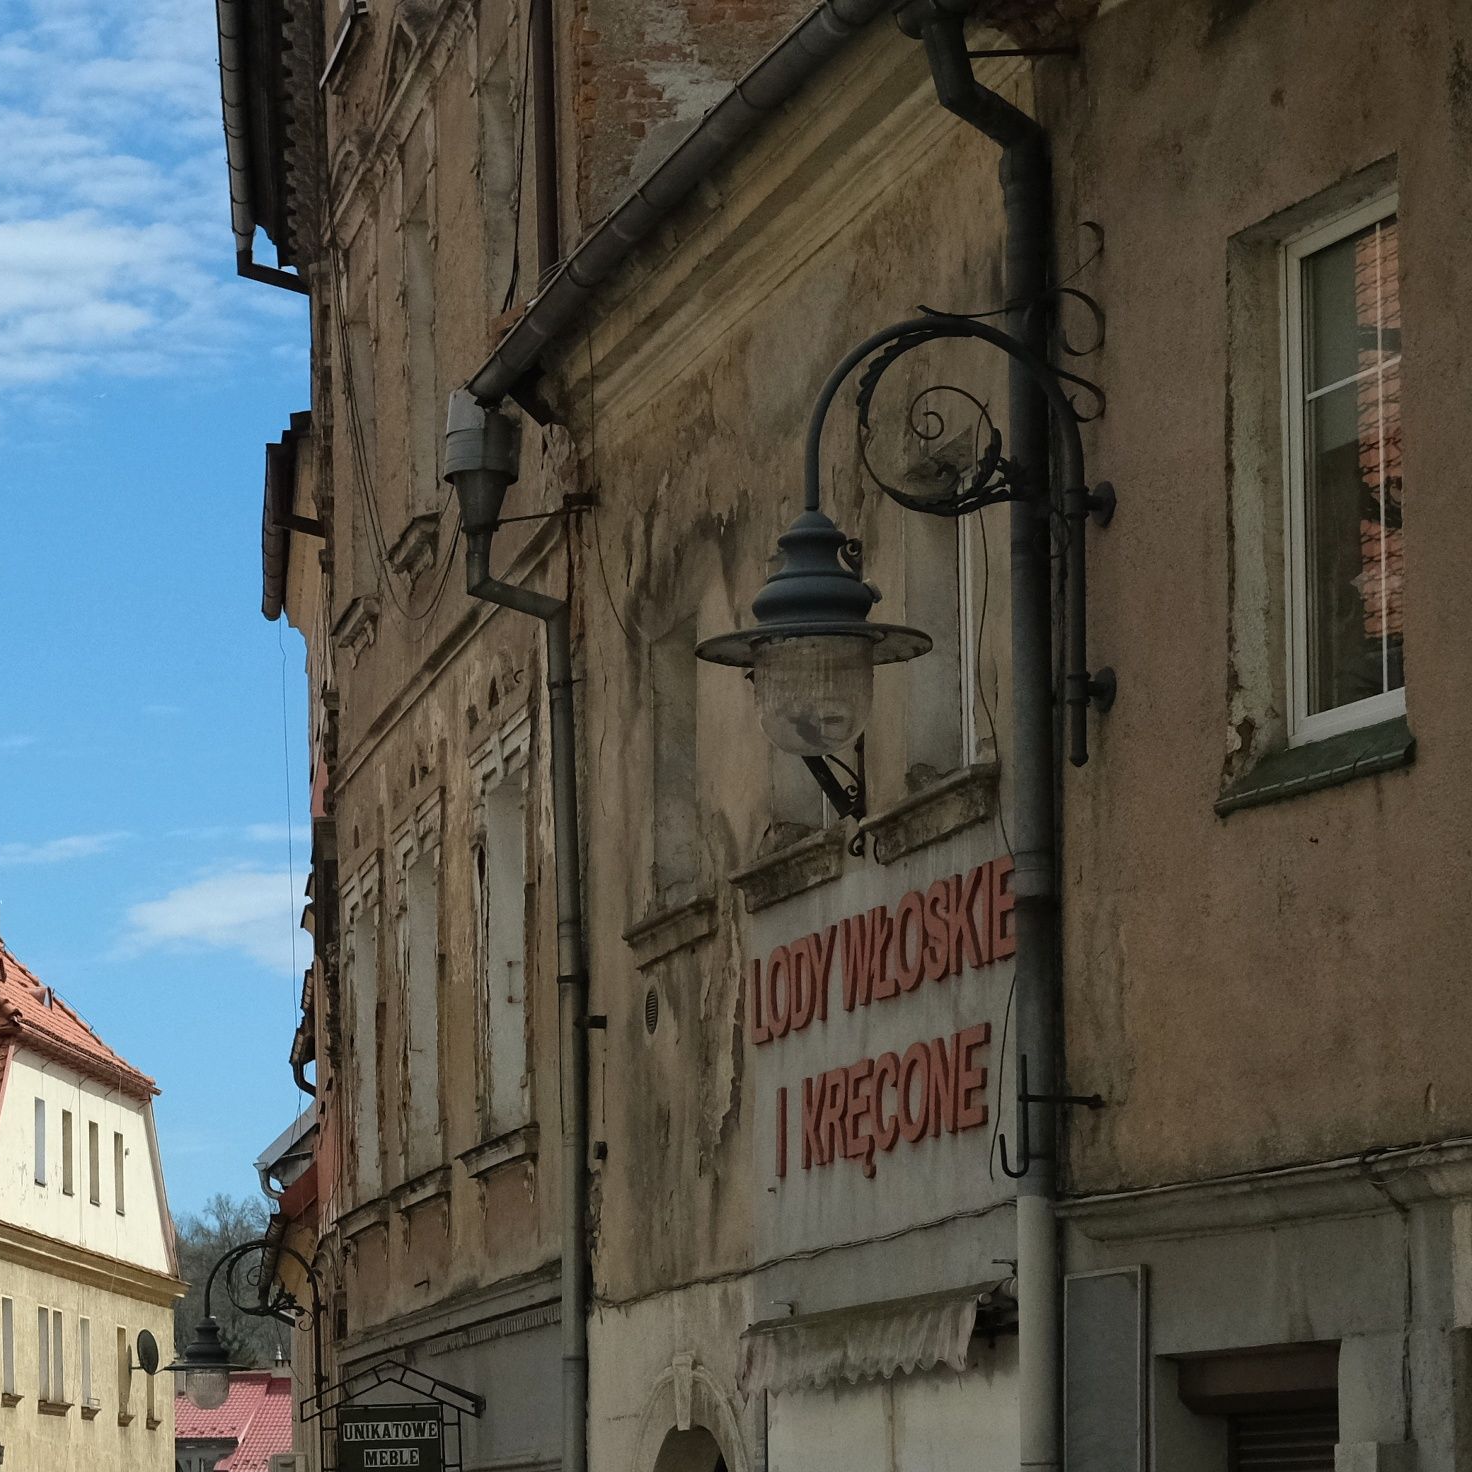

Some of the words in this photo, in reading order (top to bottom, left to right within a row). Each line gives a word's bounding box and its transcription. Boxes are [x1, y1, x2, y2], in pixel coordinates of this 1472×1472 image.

[753, 925, 837, 1044] LODY
[838, 856, 1017, 1013] WŁOSKIE
[776, 1087, 787, 1177] I
[801, 1022, 991, 1180] KRĘCONE
[343, 1422, 438, 1440] UNIKATOWE
[364, 1449, 419, 1466] MEBLE
